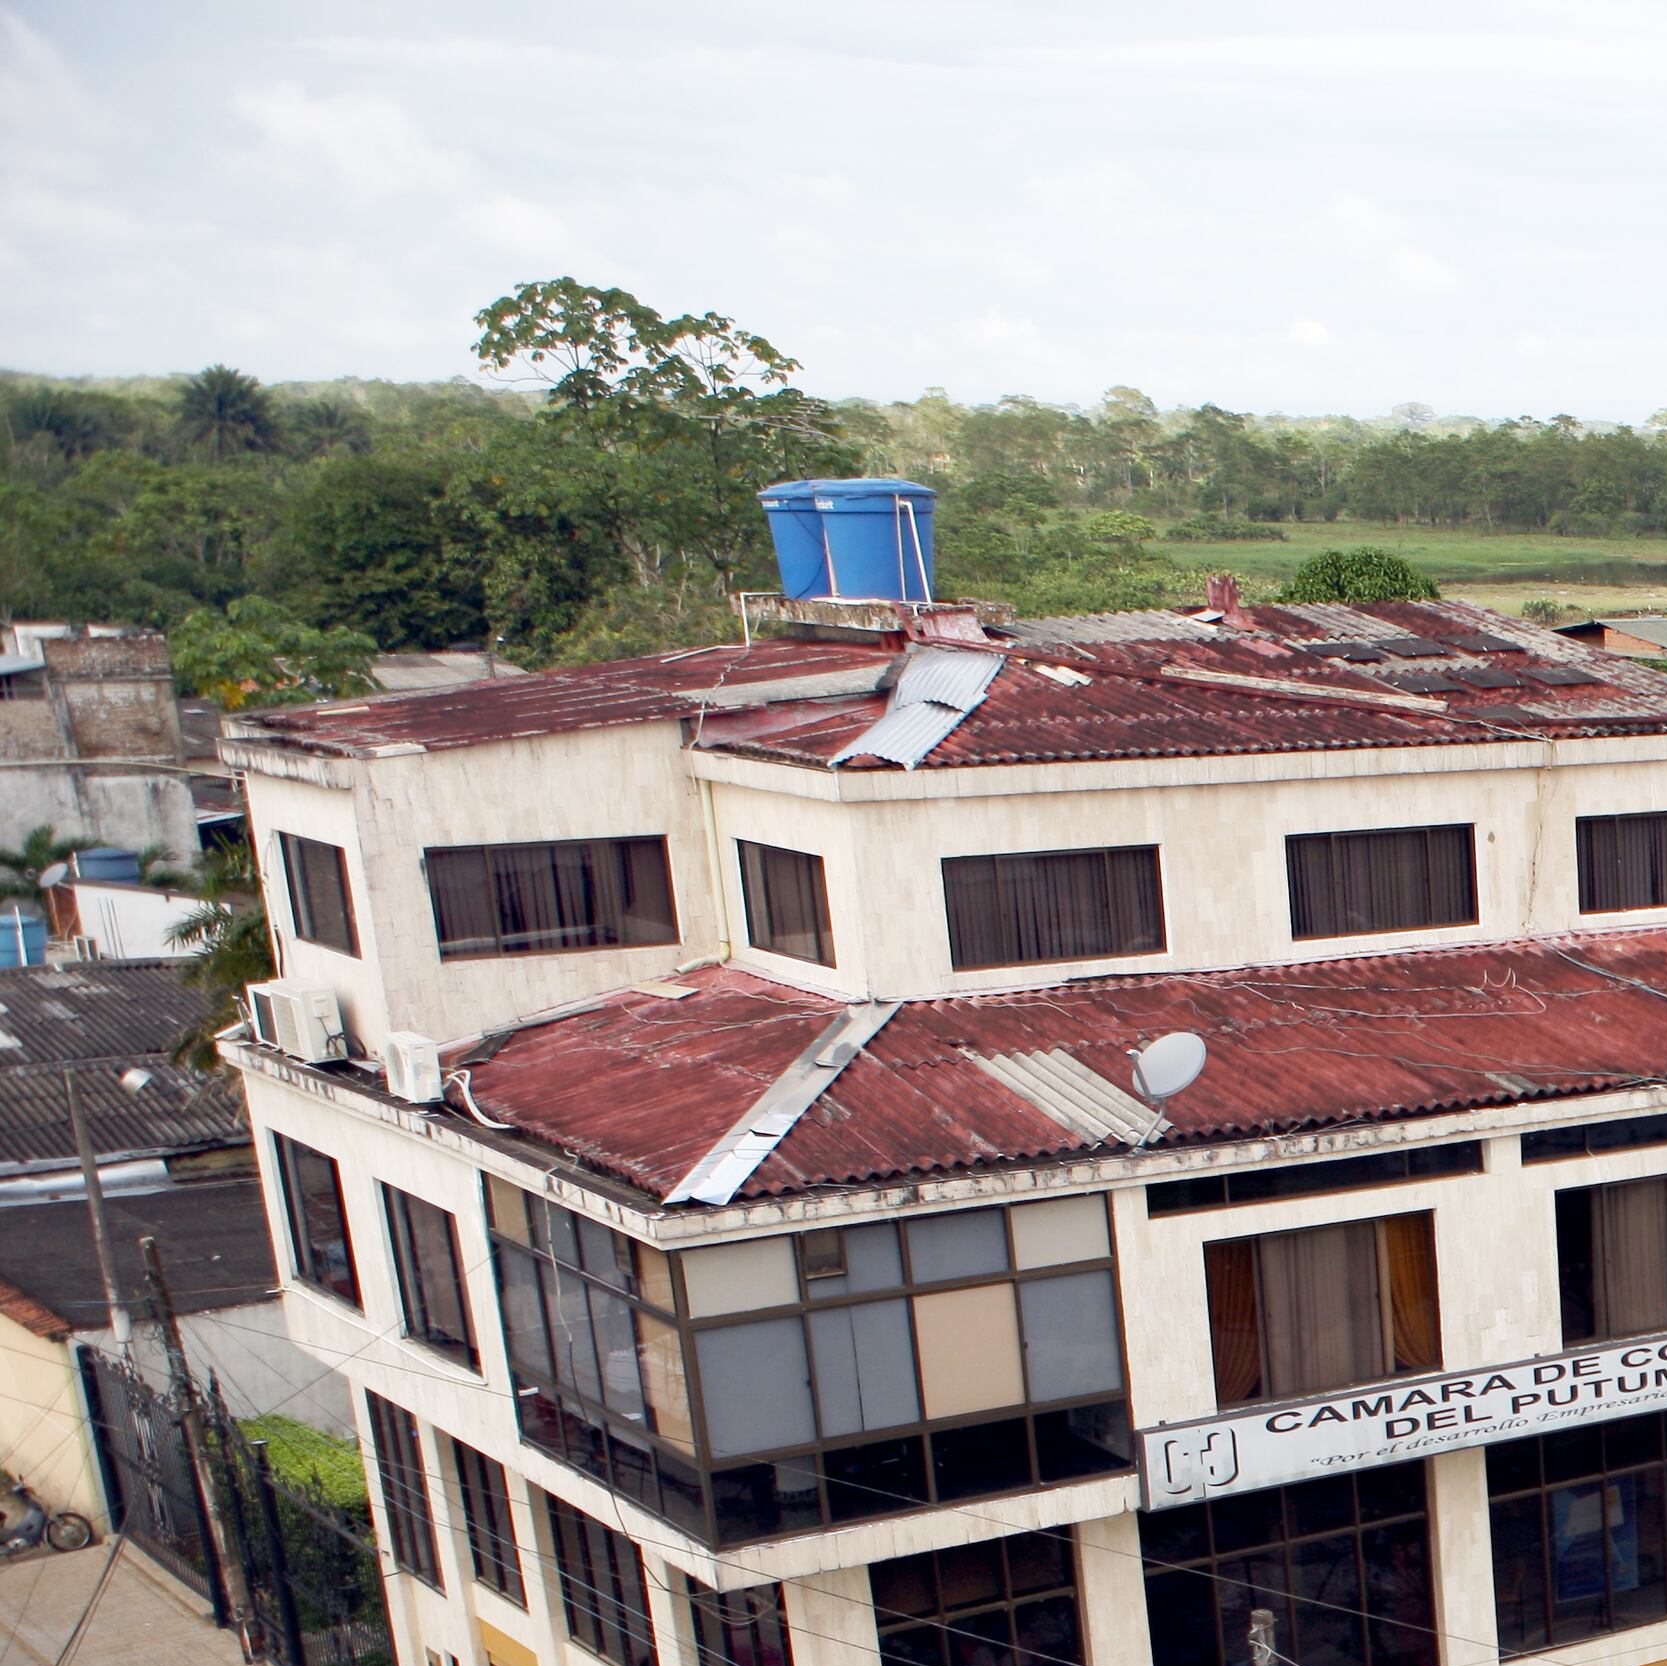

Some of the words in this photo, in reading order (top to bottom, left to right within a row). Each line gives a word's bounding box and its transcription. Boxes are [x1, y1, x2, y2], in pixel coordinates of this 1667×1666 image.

[1265, 1374, 1517, 1434] CAMARA
[1533, 1356, 1602, 1386] DE
[1376, 1442, 1401, 1457] el
[1406, 1418, 1529, 1451] desarrollo
[1385, 1404, 1493, 1440] DEL
